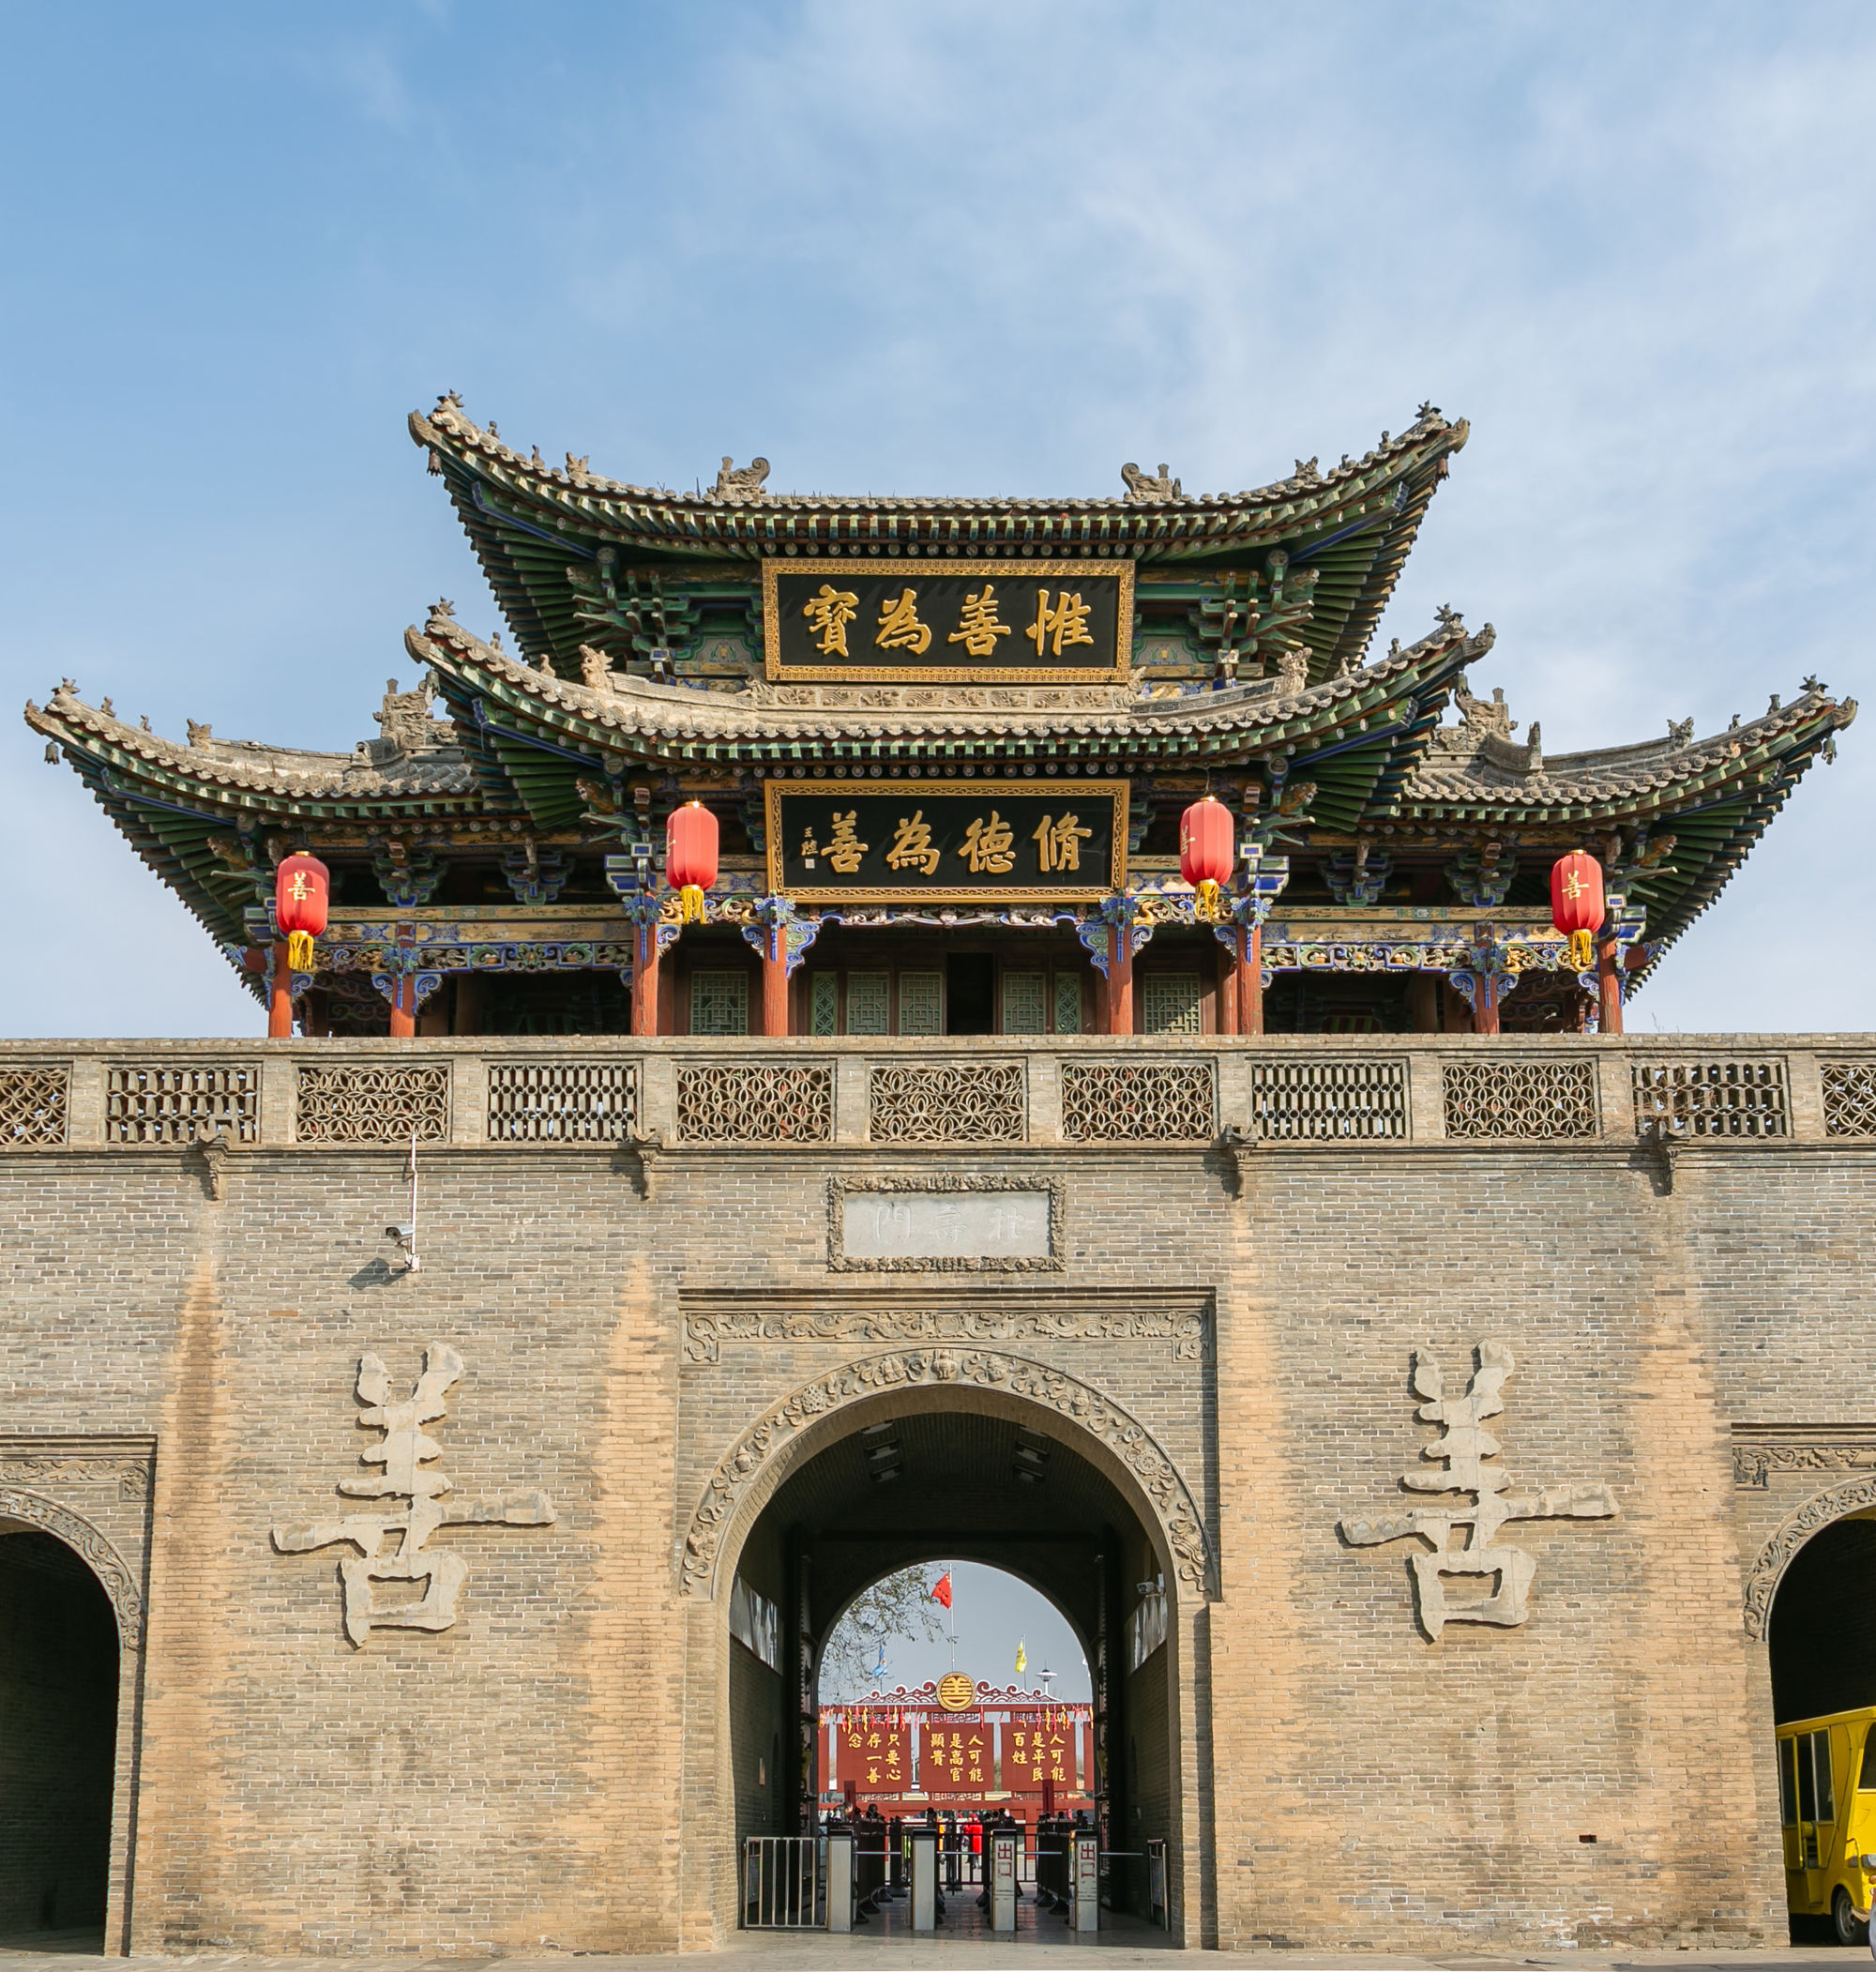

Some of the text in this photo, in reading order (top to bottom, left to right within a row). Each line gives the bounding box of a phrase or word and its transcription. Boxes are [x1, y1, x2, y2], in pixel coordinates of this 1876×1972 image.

[287, 872, 316, 902] 善
[1561, 870, 1591, 901] 善
[271, 1341, 556, 1648] 善
[1339, 1338, 1621, 1641] 善
